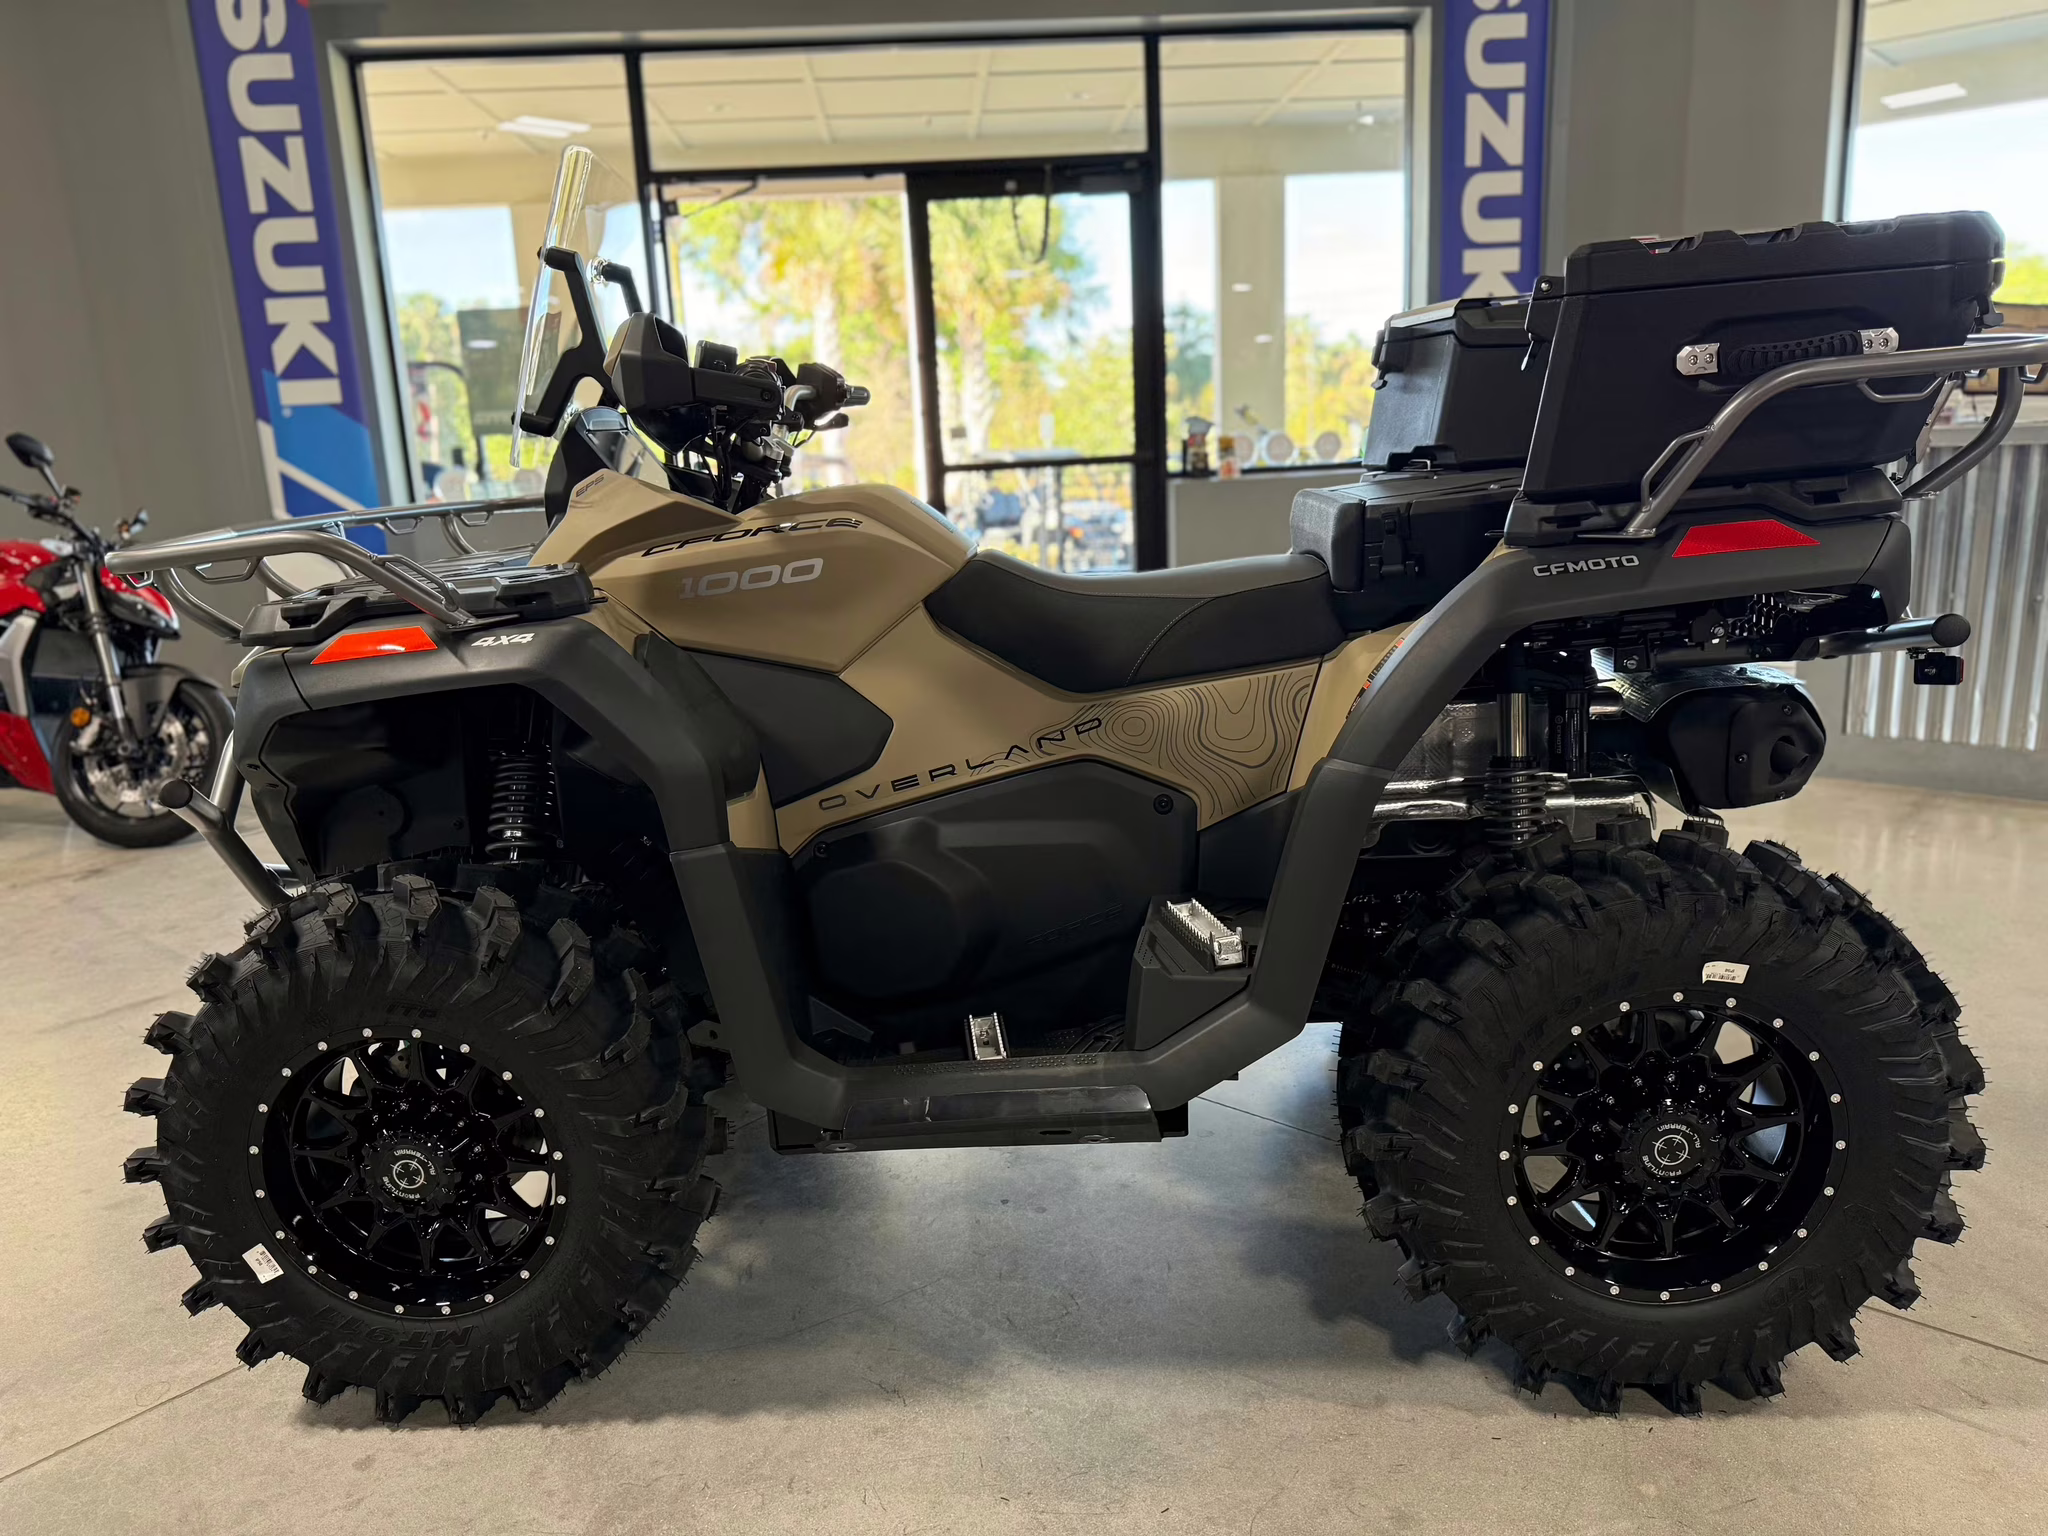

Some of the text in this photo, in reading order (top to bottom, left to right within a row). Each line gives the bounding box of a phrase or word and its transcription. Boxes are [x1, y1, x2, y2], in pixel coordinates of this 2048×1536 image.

[215, 0, 343, 405] SUZUKI
[576, 474, 604, 497] EPS
[641, 517, 863, 557] CFORCE
[679, 558, 823, 600] 1000
[1533, 555, 1639, 577] CFMOTO
[471, 633, 535, 647] 4X4
[819, 717, 1103, 810] OVERLAND
[1656, 1123, 1702, 1149] ALL-TERRAIN
[393, 1149, 436, 1176] ALL-TERRAIN
[1642, 1155, 1682, 1177] FRONTLINE
[382, 1176, 421, 1199] FRONTLINE
